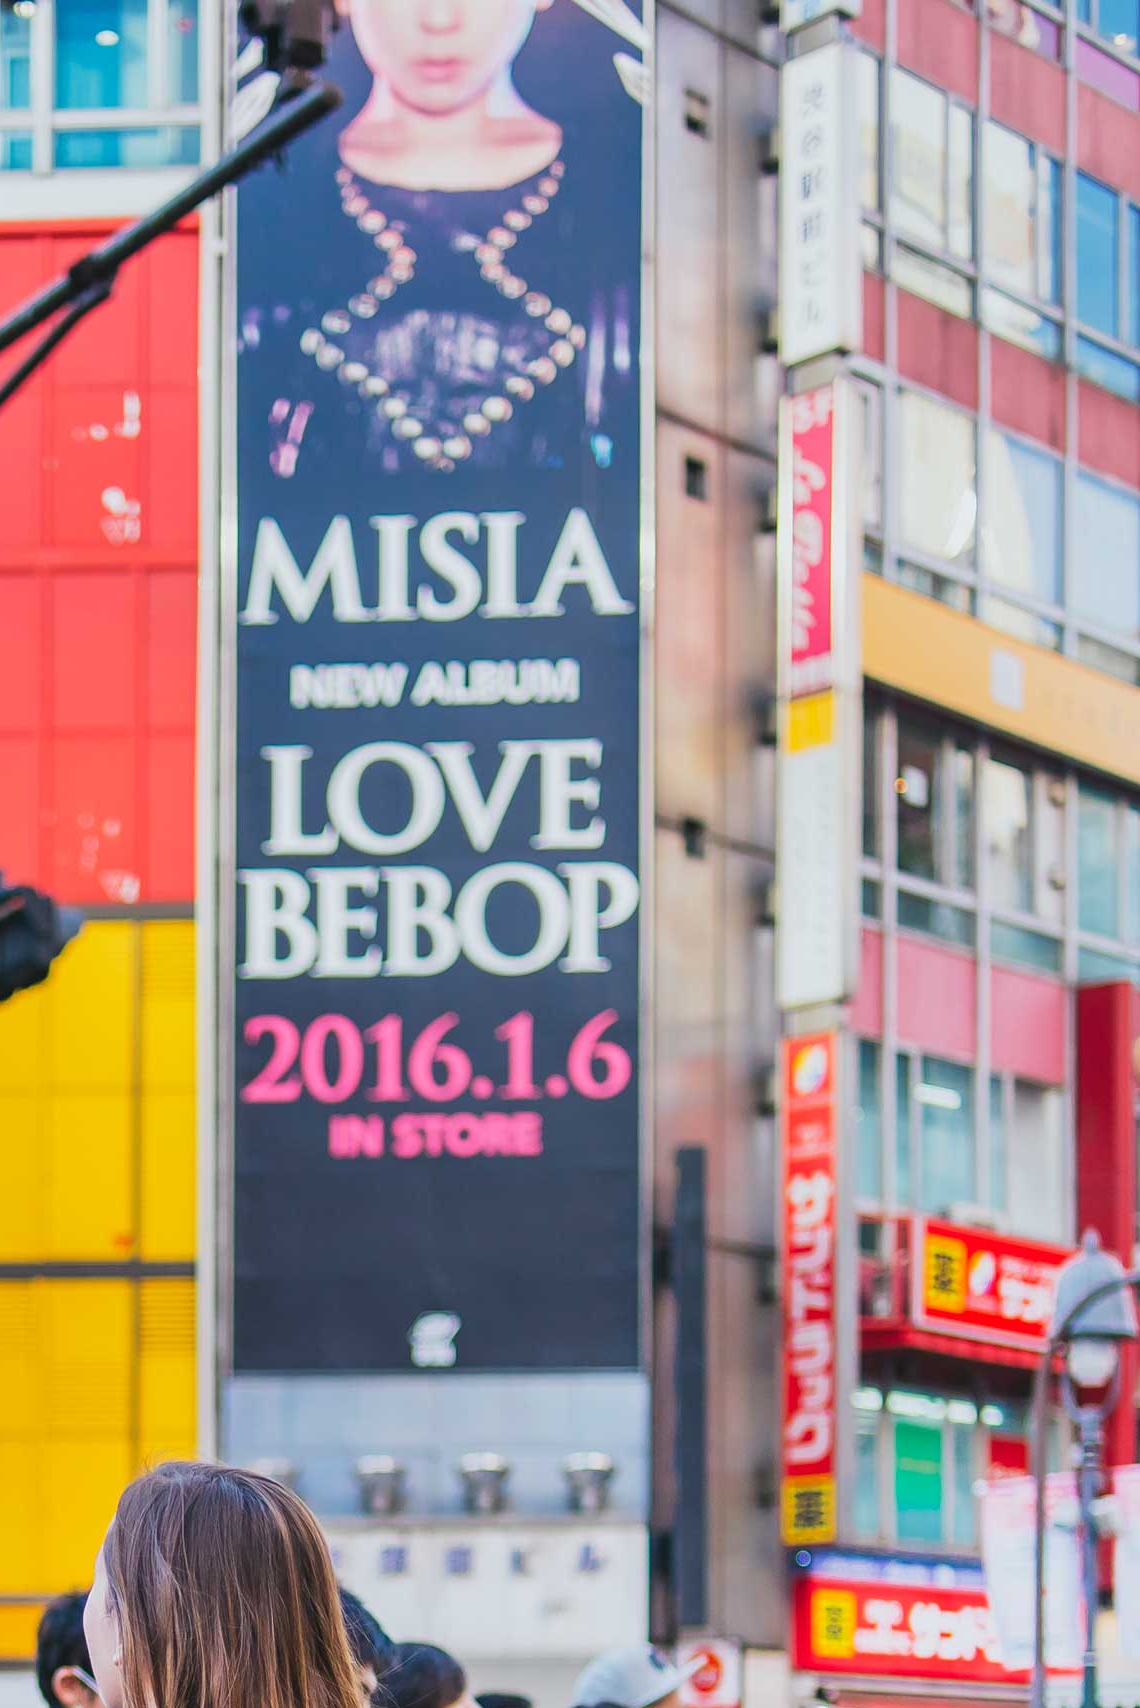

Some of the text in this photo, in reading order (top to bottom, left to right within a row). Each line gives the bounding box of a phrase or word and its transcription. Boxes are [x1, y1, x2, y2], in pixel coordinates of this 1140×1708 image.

[238, 507, 636, 625] MISIA
[289, 657, 580, 709] NEW ALBUM
[260, 738, 606, 856] LOVE
[237, 861, 639, 979] BEBOP
[240, 1008, 632, 1104] 2016.1.6
[329, 1112, 543, 1158] IN STORE
